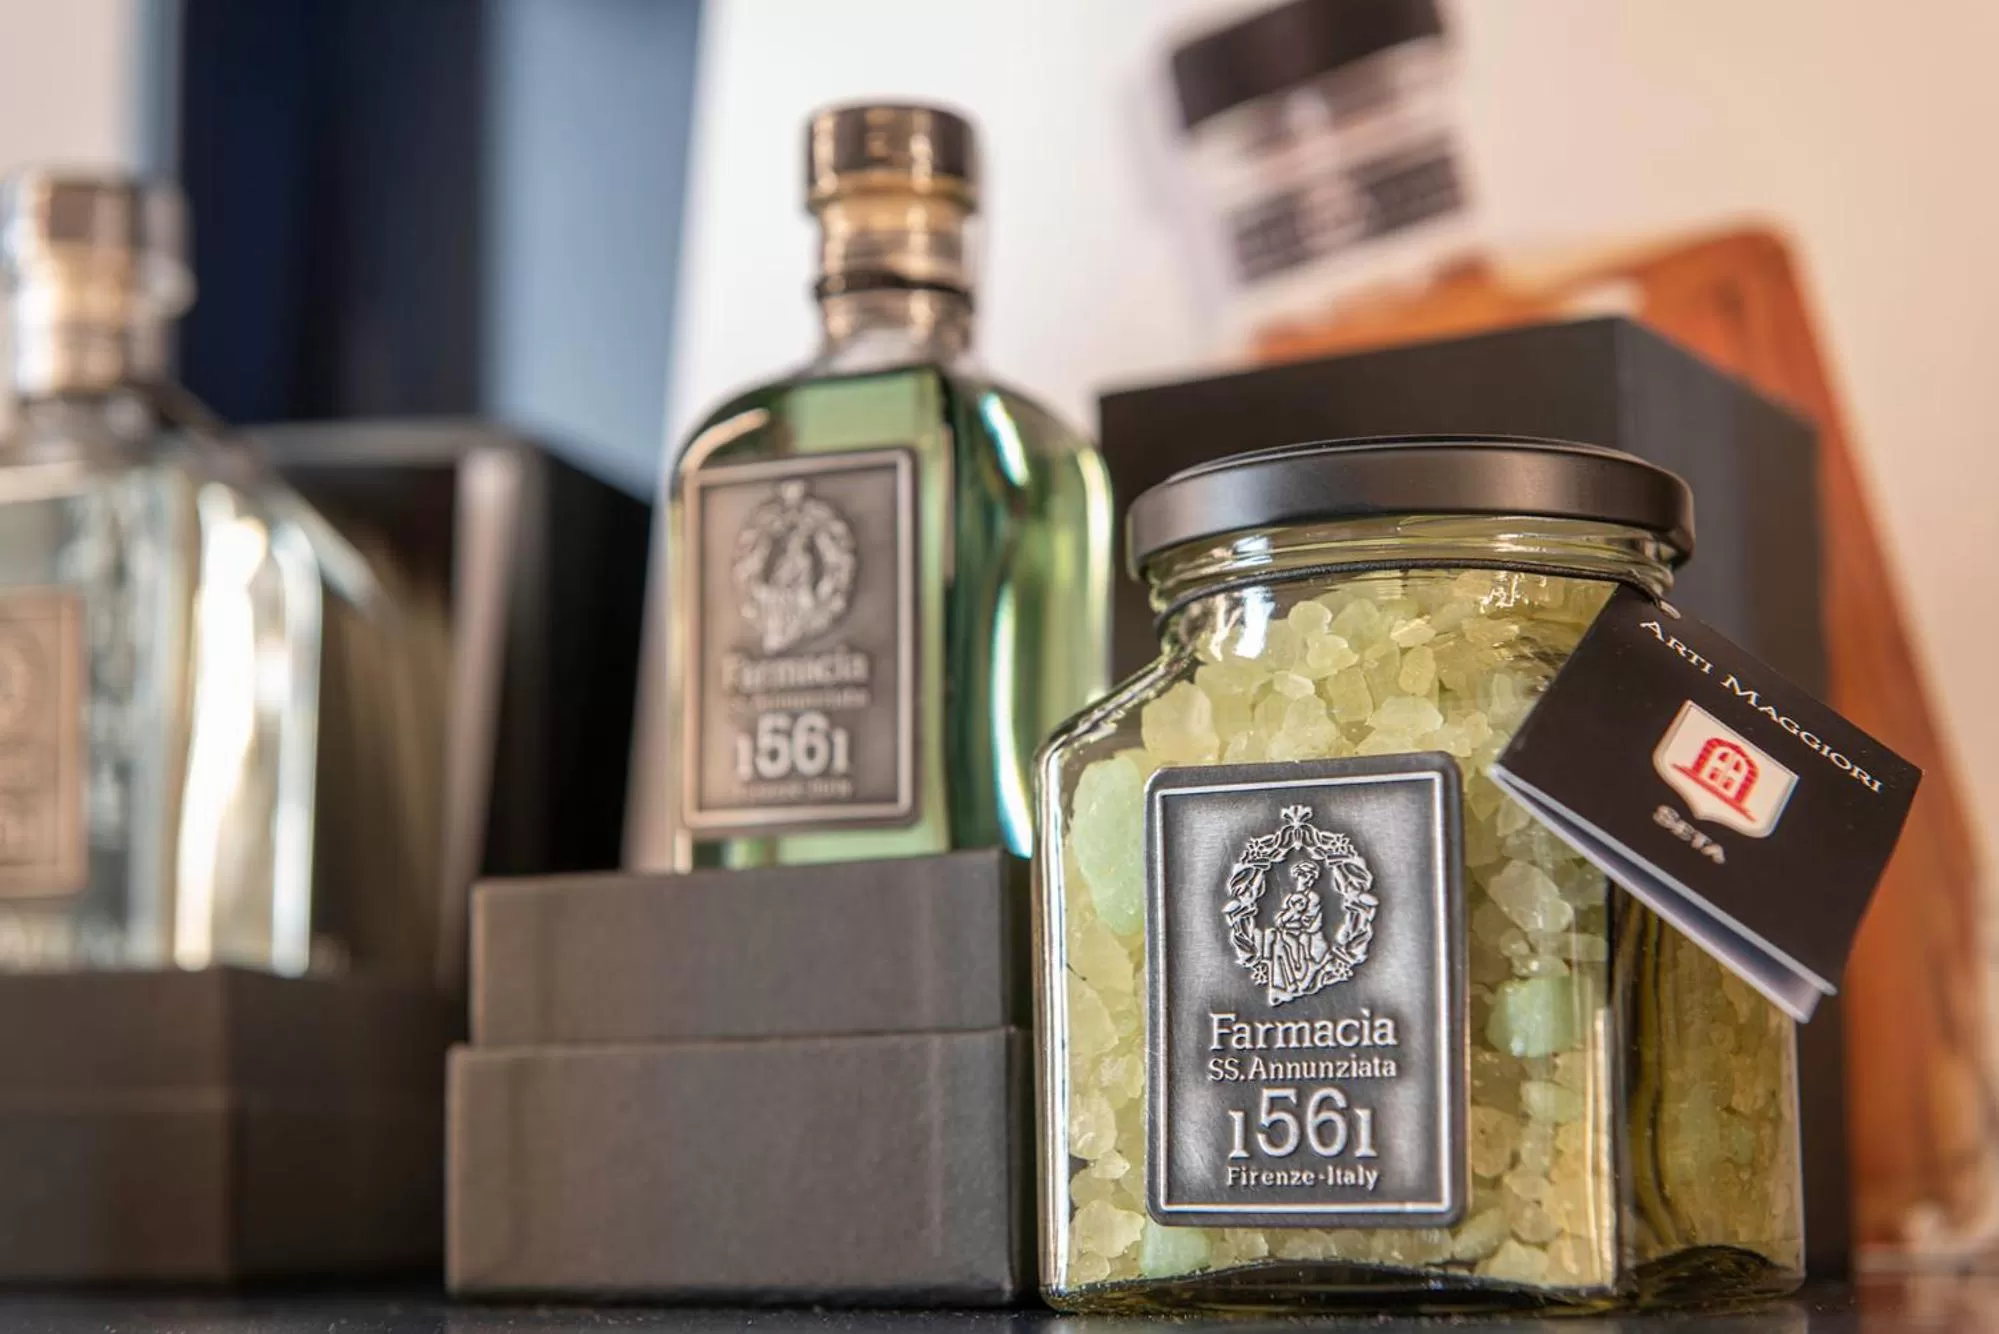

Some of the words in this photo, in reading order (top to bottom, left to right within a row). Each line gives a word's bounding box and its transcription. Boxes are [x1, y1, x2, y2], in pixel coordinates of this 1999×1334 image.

[1640, 620, 1714, 674] ARTI
[1720, 673, 1884, 794] MAGGIORI
[734, 710, 849, 782] 1561
[1652, 804, 1727, 865] SETA
[1208, 1008, 1398, 1051] Farmacia
[1227, 1086, 1378, 1159] 1561
